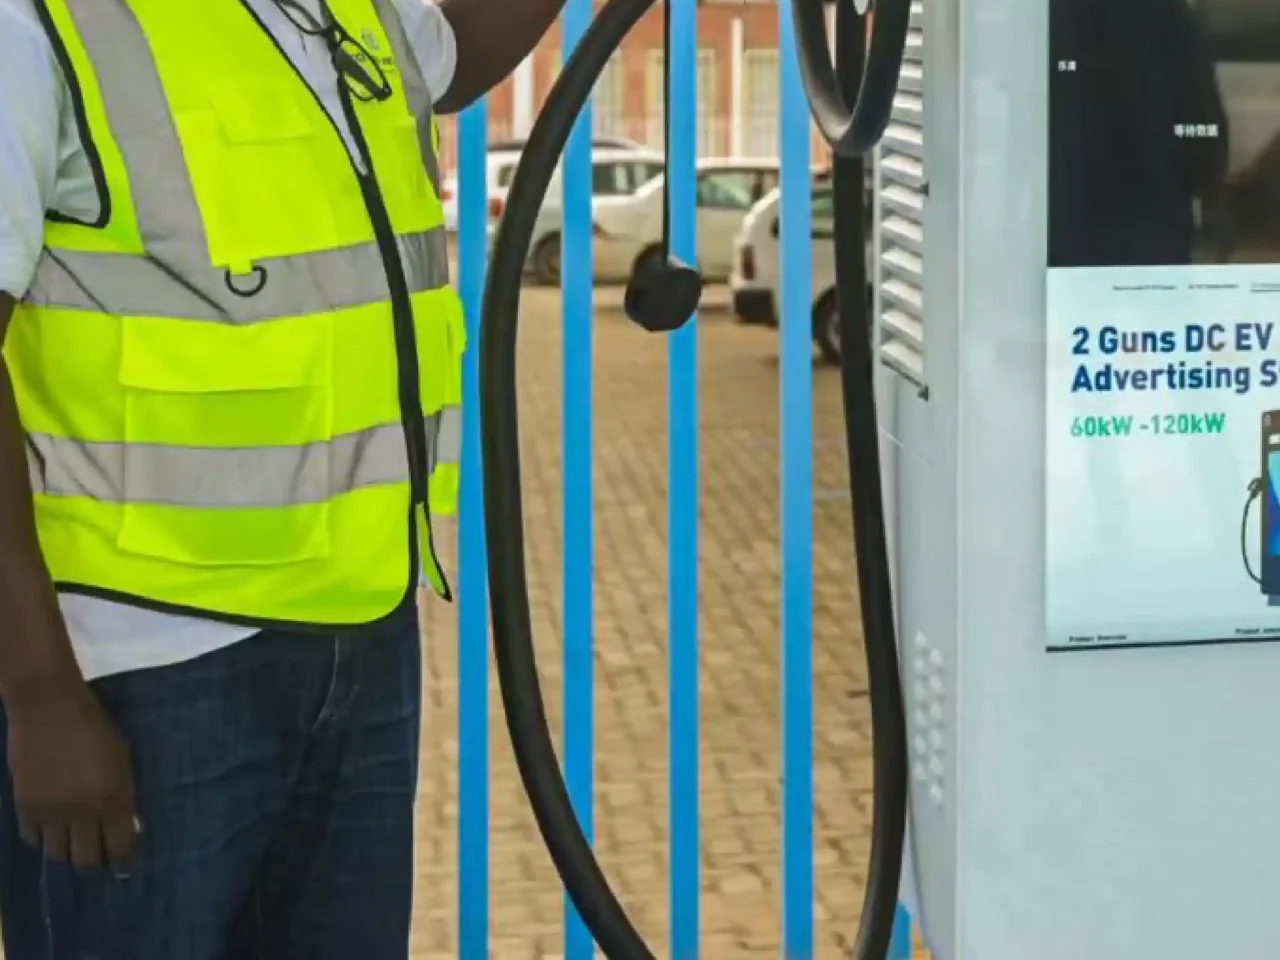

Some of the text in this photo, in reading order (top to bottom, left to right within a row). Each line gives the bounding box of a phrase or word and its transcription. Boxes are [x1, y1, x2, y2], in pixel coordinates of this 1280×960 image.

[1072, 327, 1090, 355] 2
[1099, 326, 1176, 354] Guns
[1184, 324, 1226, 353] DC
[1234, 323, 1274, 351] EV
[1070, 360, 1250, 395] Advertising
[1070, 415, 1133, 438] 60kW
